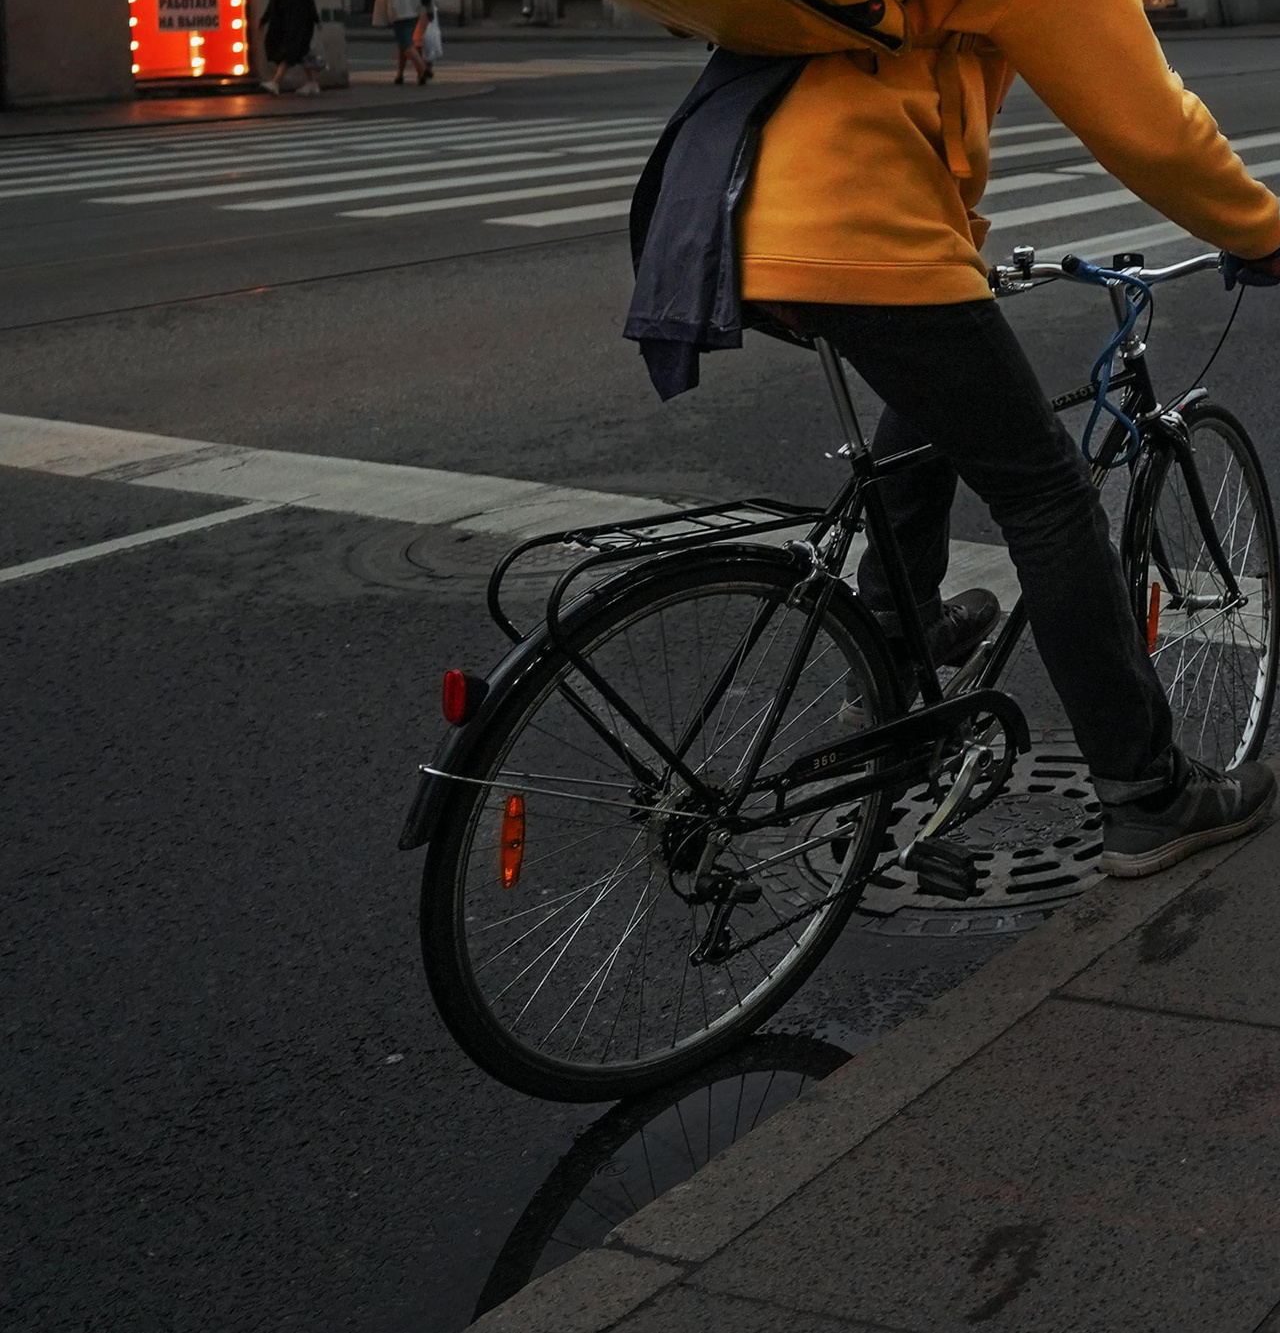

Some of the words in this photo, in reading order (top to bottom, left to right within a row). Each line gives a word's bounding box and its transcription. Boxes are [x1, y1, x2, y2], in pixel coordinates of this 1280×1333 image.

[159, 15, 174, 28] НА
[178, 14, 219, 27] ВЫНОС
[813, 752, 837, 770] 360
